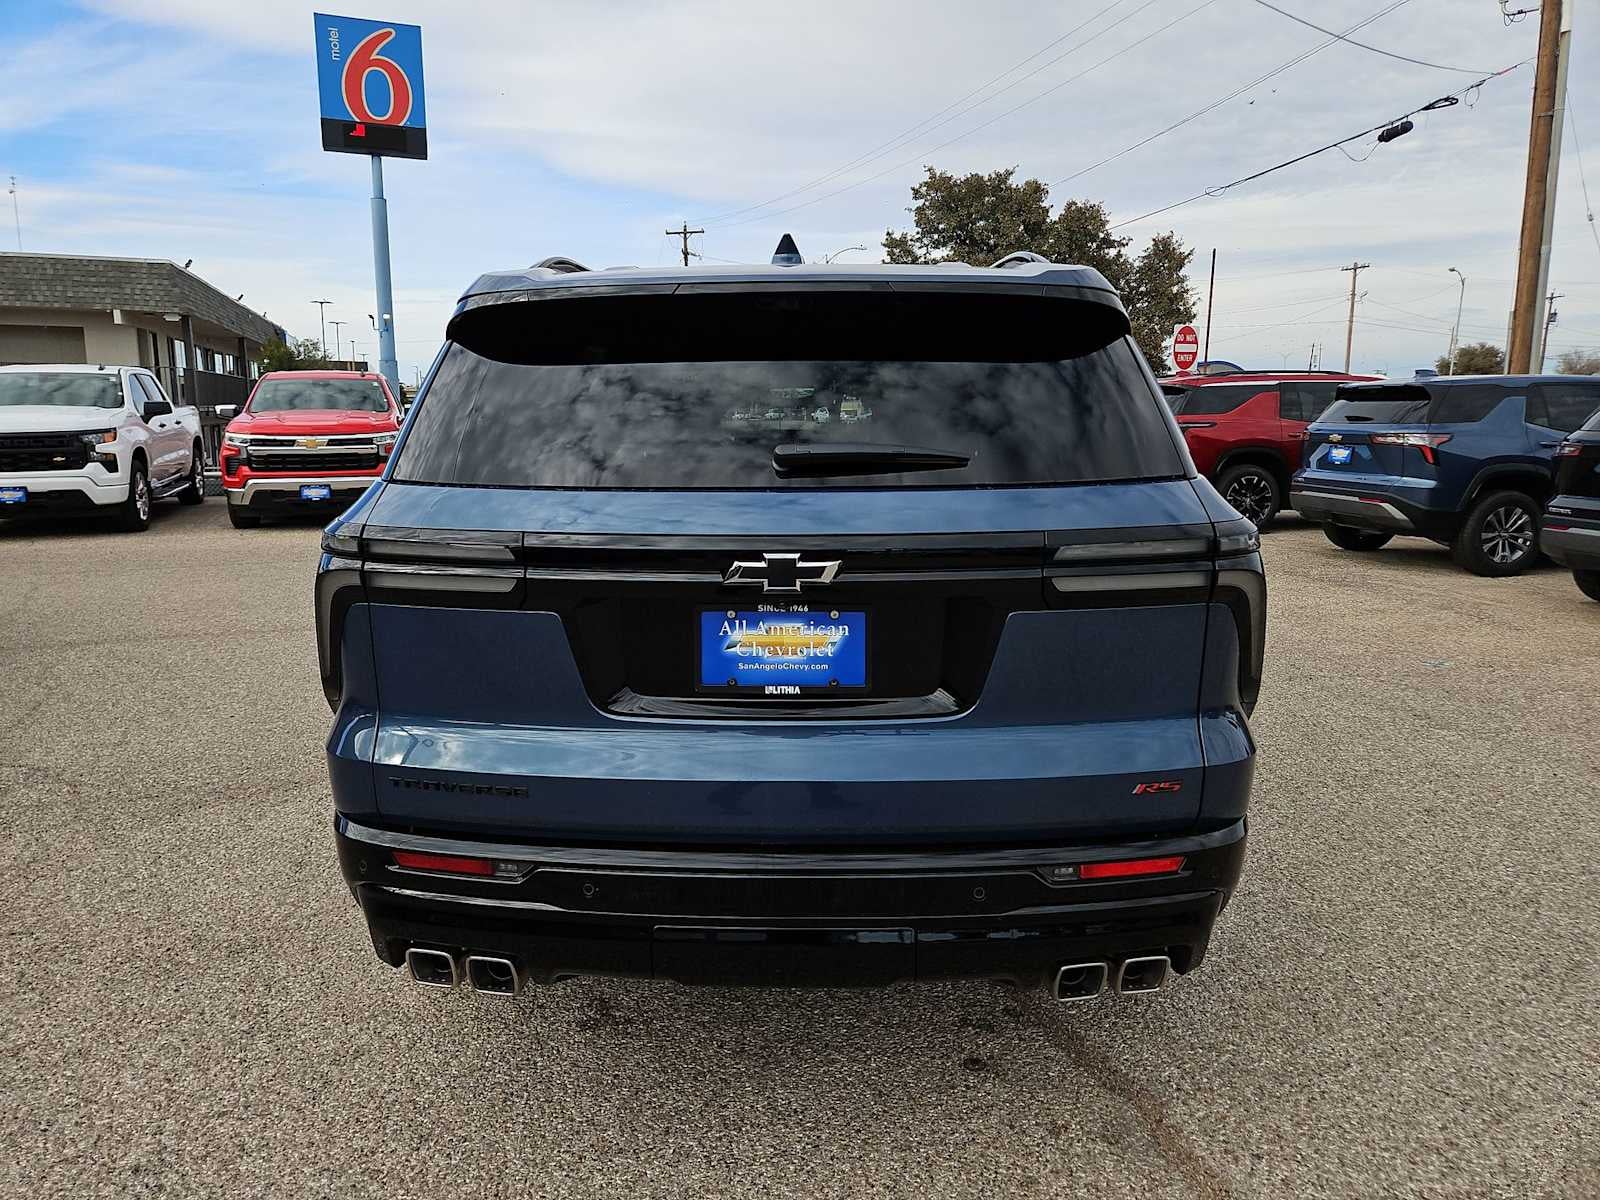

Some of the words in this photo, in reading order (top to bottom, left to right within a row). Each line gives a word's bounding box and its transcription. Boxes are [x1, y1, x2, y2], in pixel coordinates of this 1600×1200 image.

[328, 27, 340, 61] motel
[341, 27, 413, 126] 6
[1176, 333, 1185, 342] DO
[1186, 334, 1196, 342] NOT
[1177, 354, 1193, 362] ENTER
[789, 604, 809, 612] 1946
[719, 620, 748, 636] All
[756, 620, 849, 637] American
[736, 641, 834, 657] Chevrolet
[738, 662, 829, 671] SanAngeloChevy.com
[388, 776, 530, 798] TRAVERSE
[1131, 781, 1183, 795] RS
